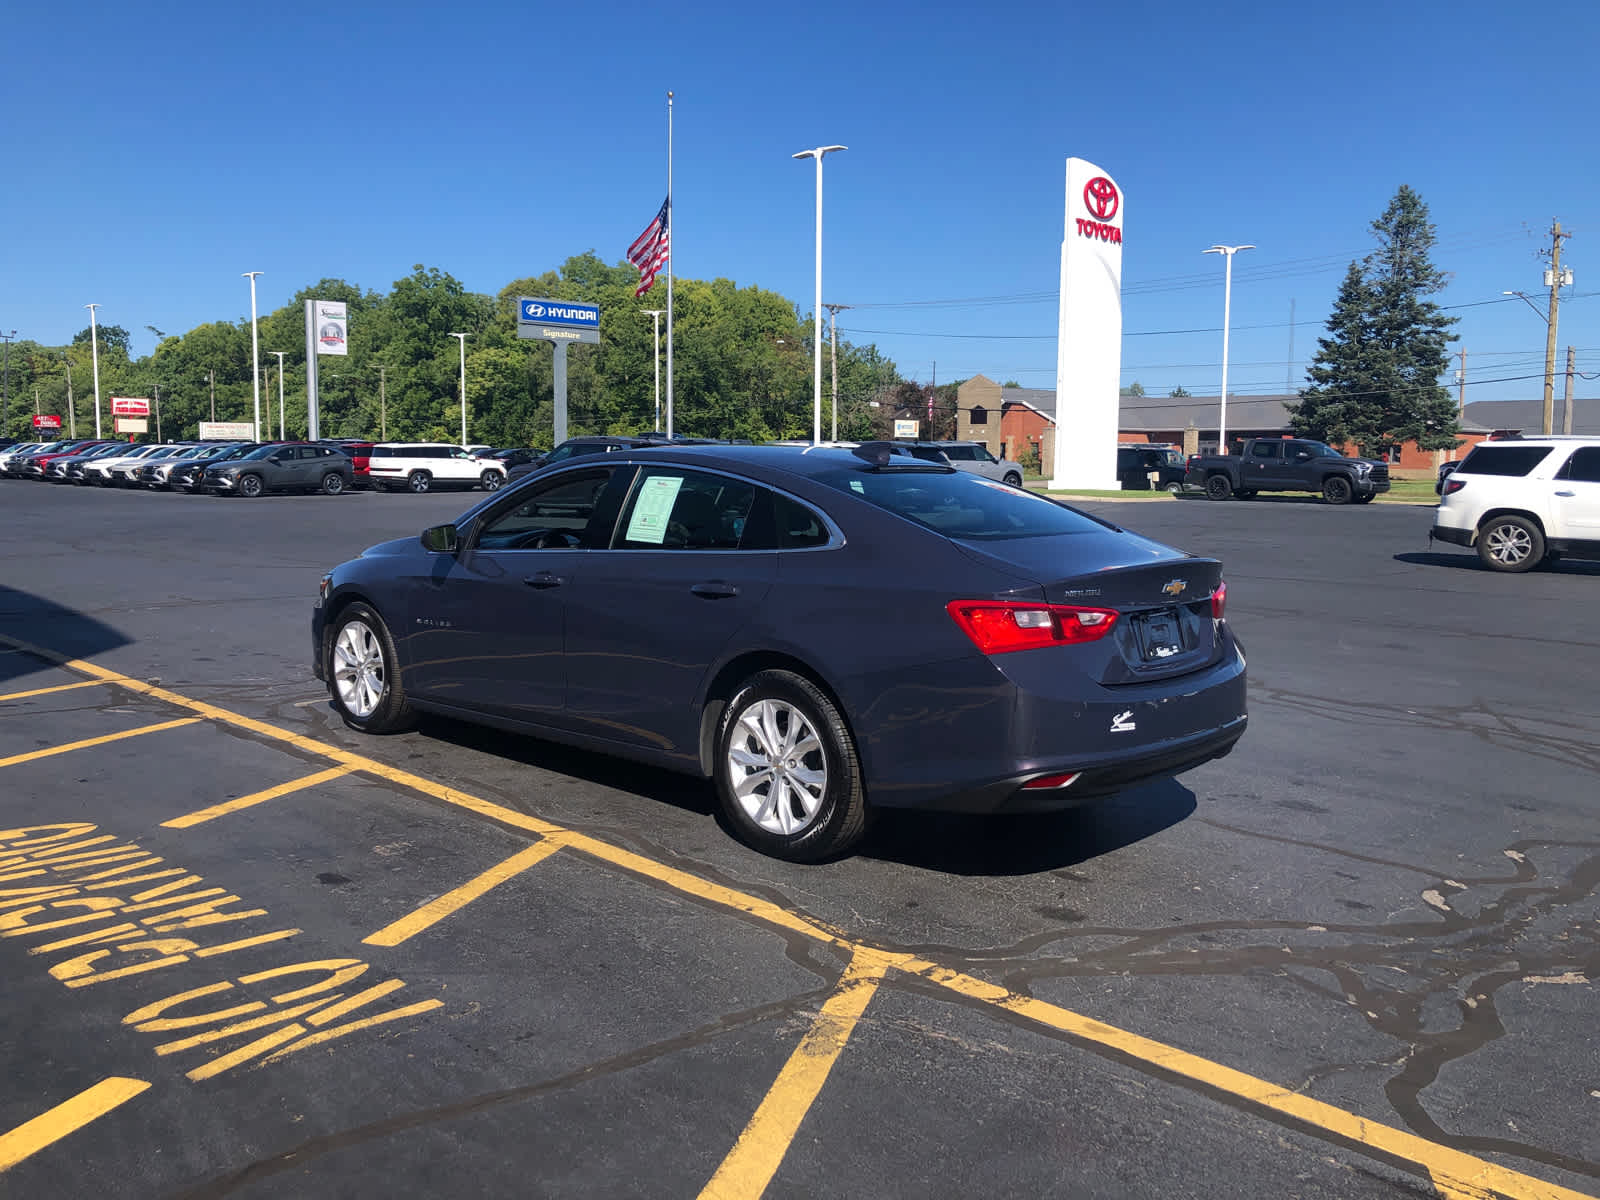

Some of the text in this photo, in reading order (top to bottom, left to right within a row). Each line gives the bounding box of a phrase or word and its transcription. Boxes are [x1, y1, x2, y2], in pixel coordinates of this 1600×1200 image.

[1076, 218, 1122, 245] TOYOTA
[548, 307, 597, 320] HYUNDAI
[543, 328, 581, 339] Signature
[122, 959, 444, 1081] NO
